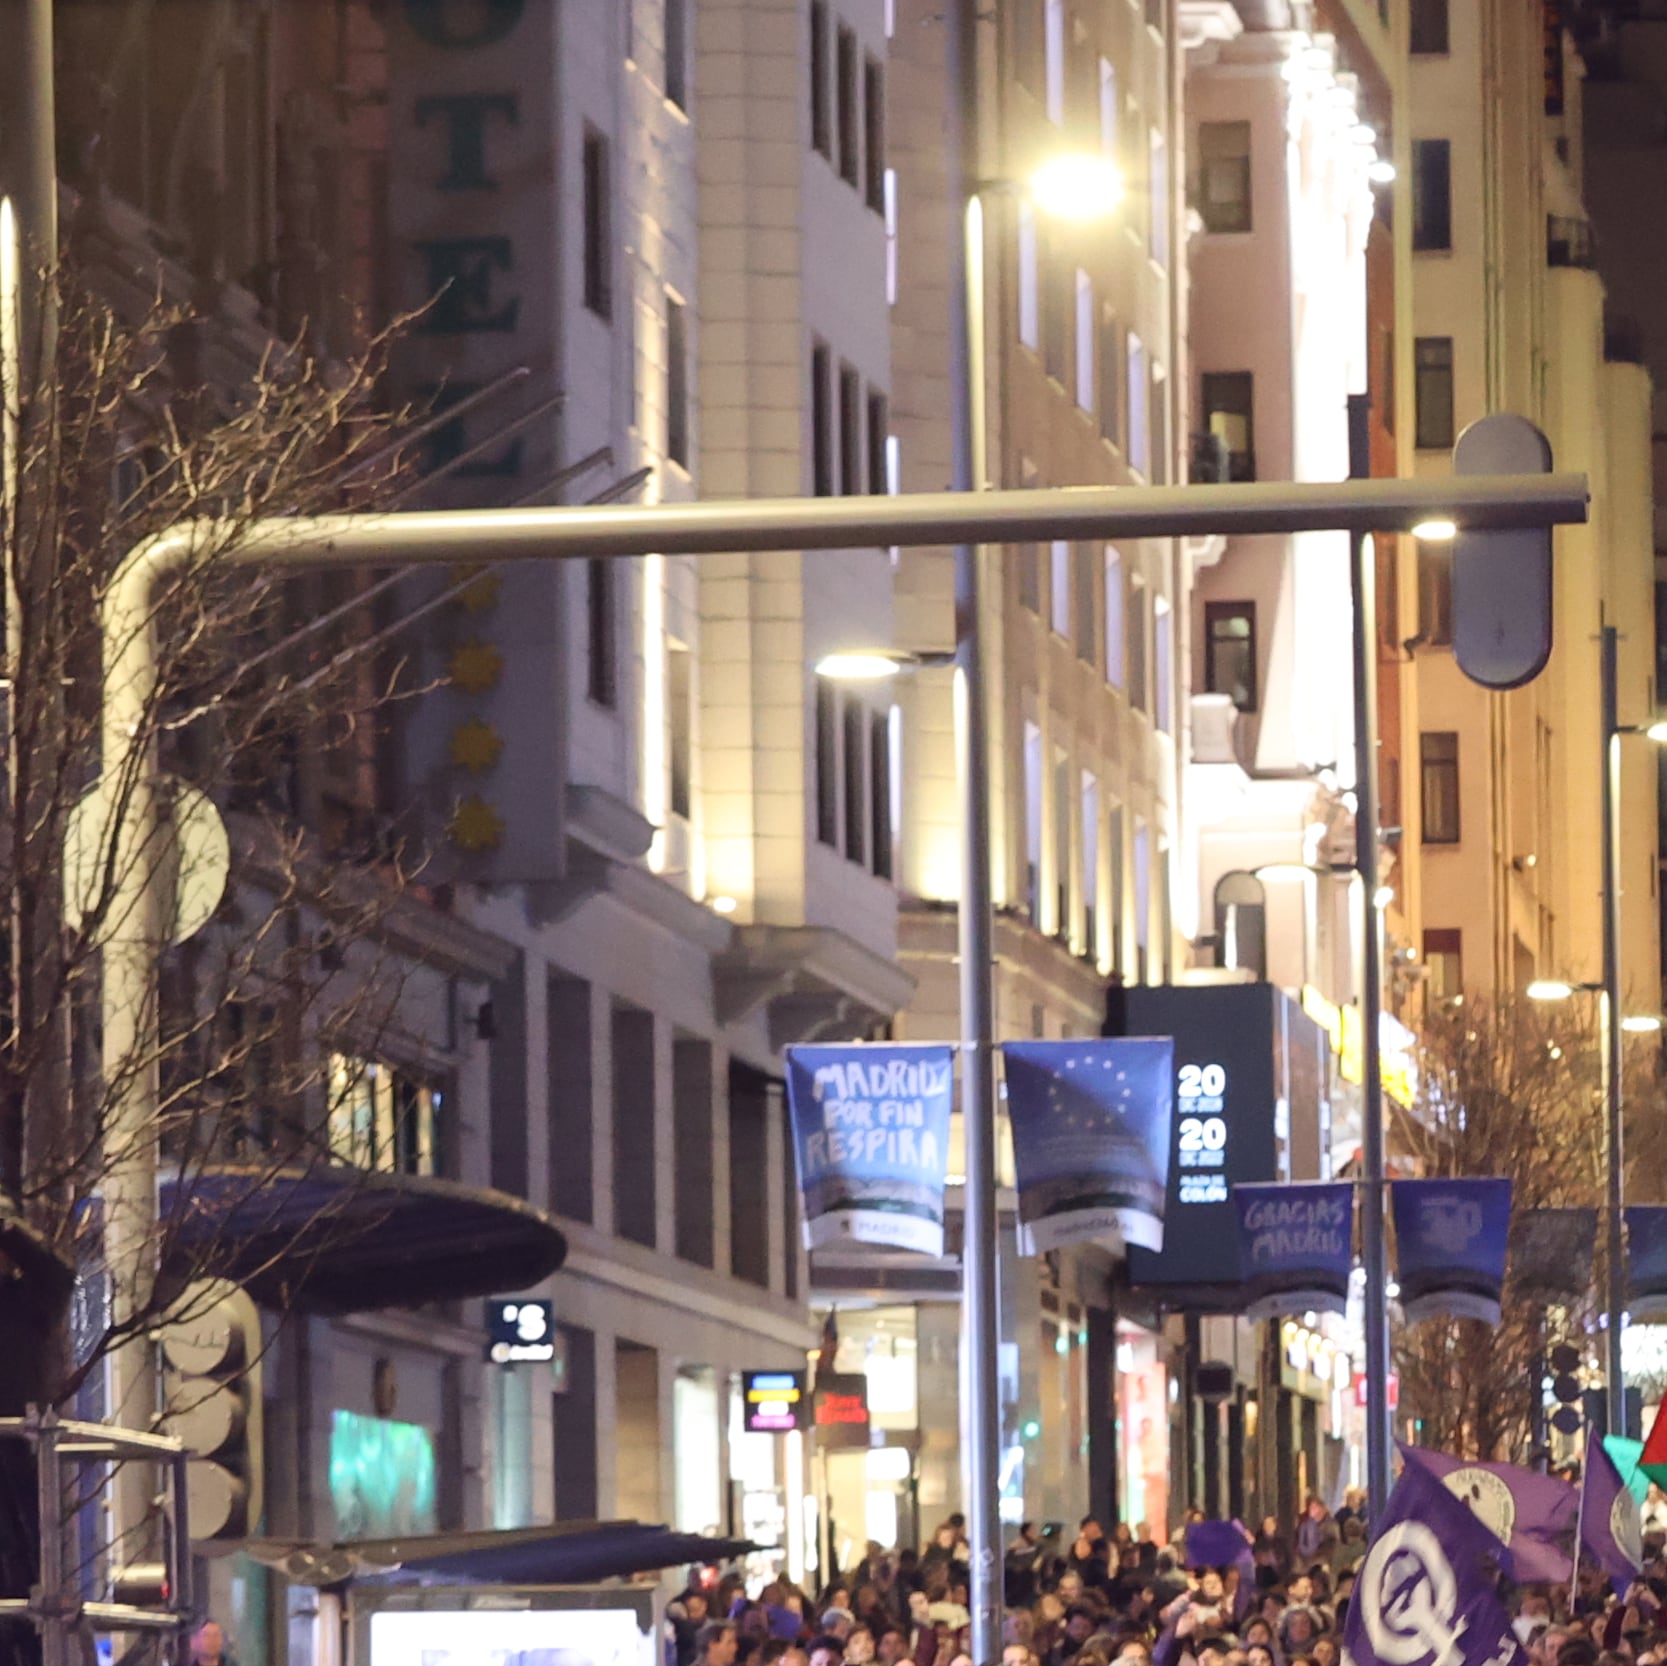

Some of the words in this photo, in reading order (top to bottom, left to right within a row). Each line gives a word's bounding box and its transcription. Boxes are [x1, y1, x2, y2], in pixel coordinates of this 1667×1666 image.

[812, 1060, 947, 1102] MADRID
[1177, 1063, 1227, 1098] 20
[824, 1099, 873, 1129] POR
[879, 1099, 924, 1128] FIN
[806, 1129, 938, 1171] RESPIRA
[1179, 1117, 1227, 1151] 20
[1244, 1198, 1344, 1231] GRACIAS
[1251, 1227, 1344, 1261] MADRID
